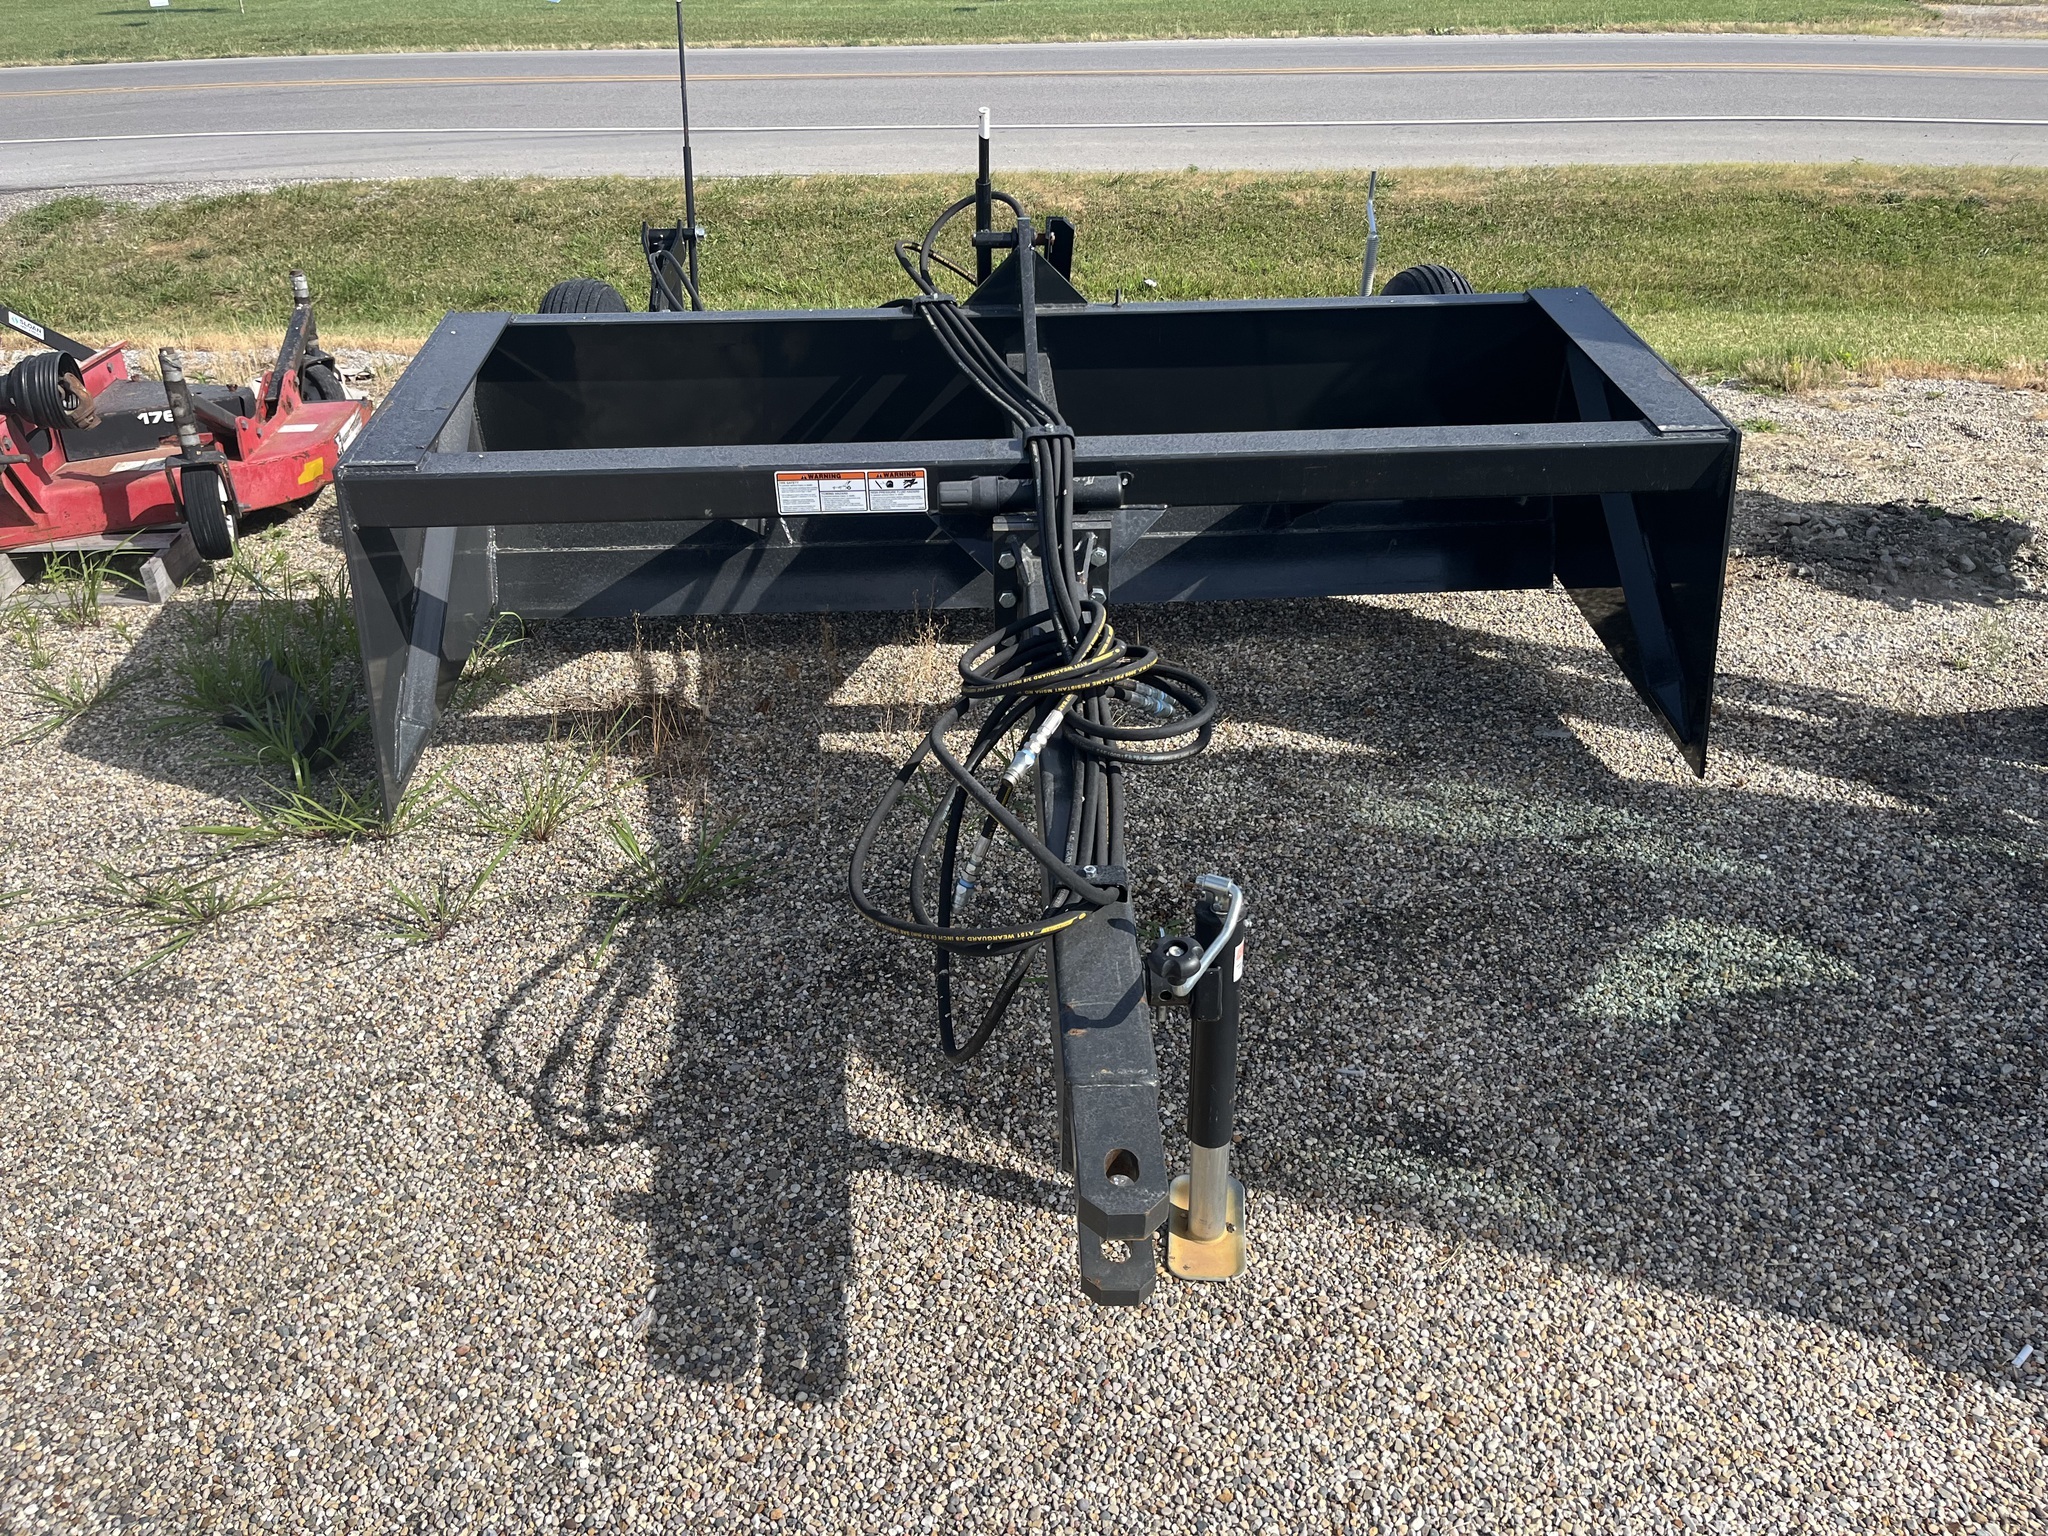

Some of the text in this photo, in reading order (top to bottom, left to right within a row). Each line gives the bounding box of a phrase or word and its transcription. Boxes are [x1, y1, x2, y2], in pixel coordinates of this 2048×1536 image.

[1054, 683, 1091, 692] RESISTANT
[967, 933, 1015, 941] WEARGUARD
[1017, 930, 1035, 938] A151
